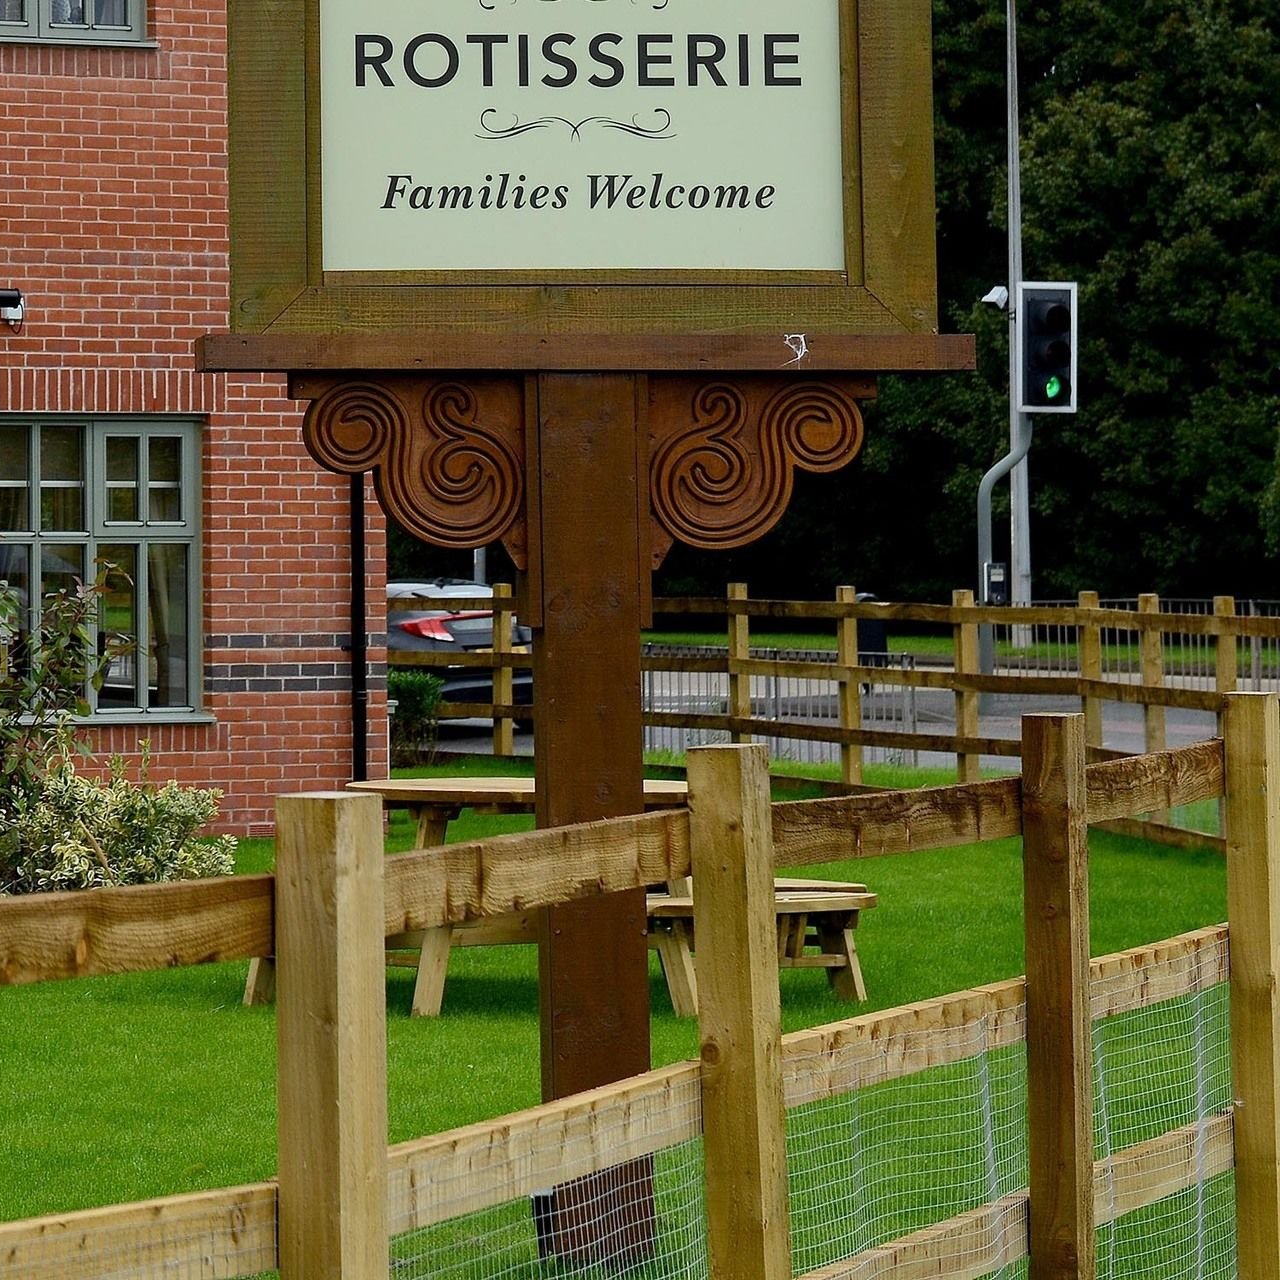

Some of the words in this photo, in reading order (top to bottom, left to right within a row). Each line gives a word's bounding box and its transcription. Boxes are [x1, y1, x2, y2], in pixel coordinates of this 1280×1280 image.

[354, 32, 802, 89] ROTISSERIE
[380, 173, 569, 210] Families
[586, 173, 776, 209] Welcome
